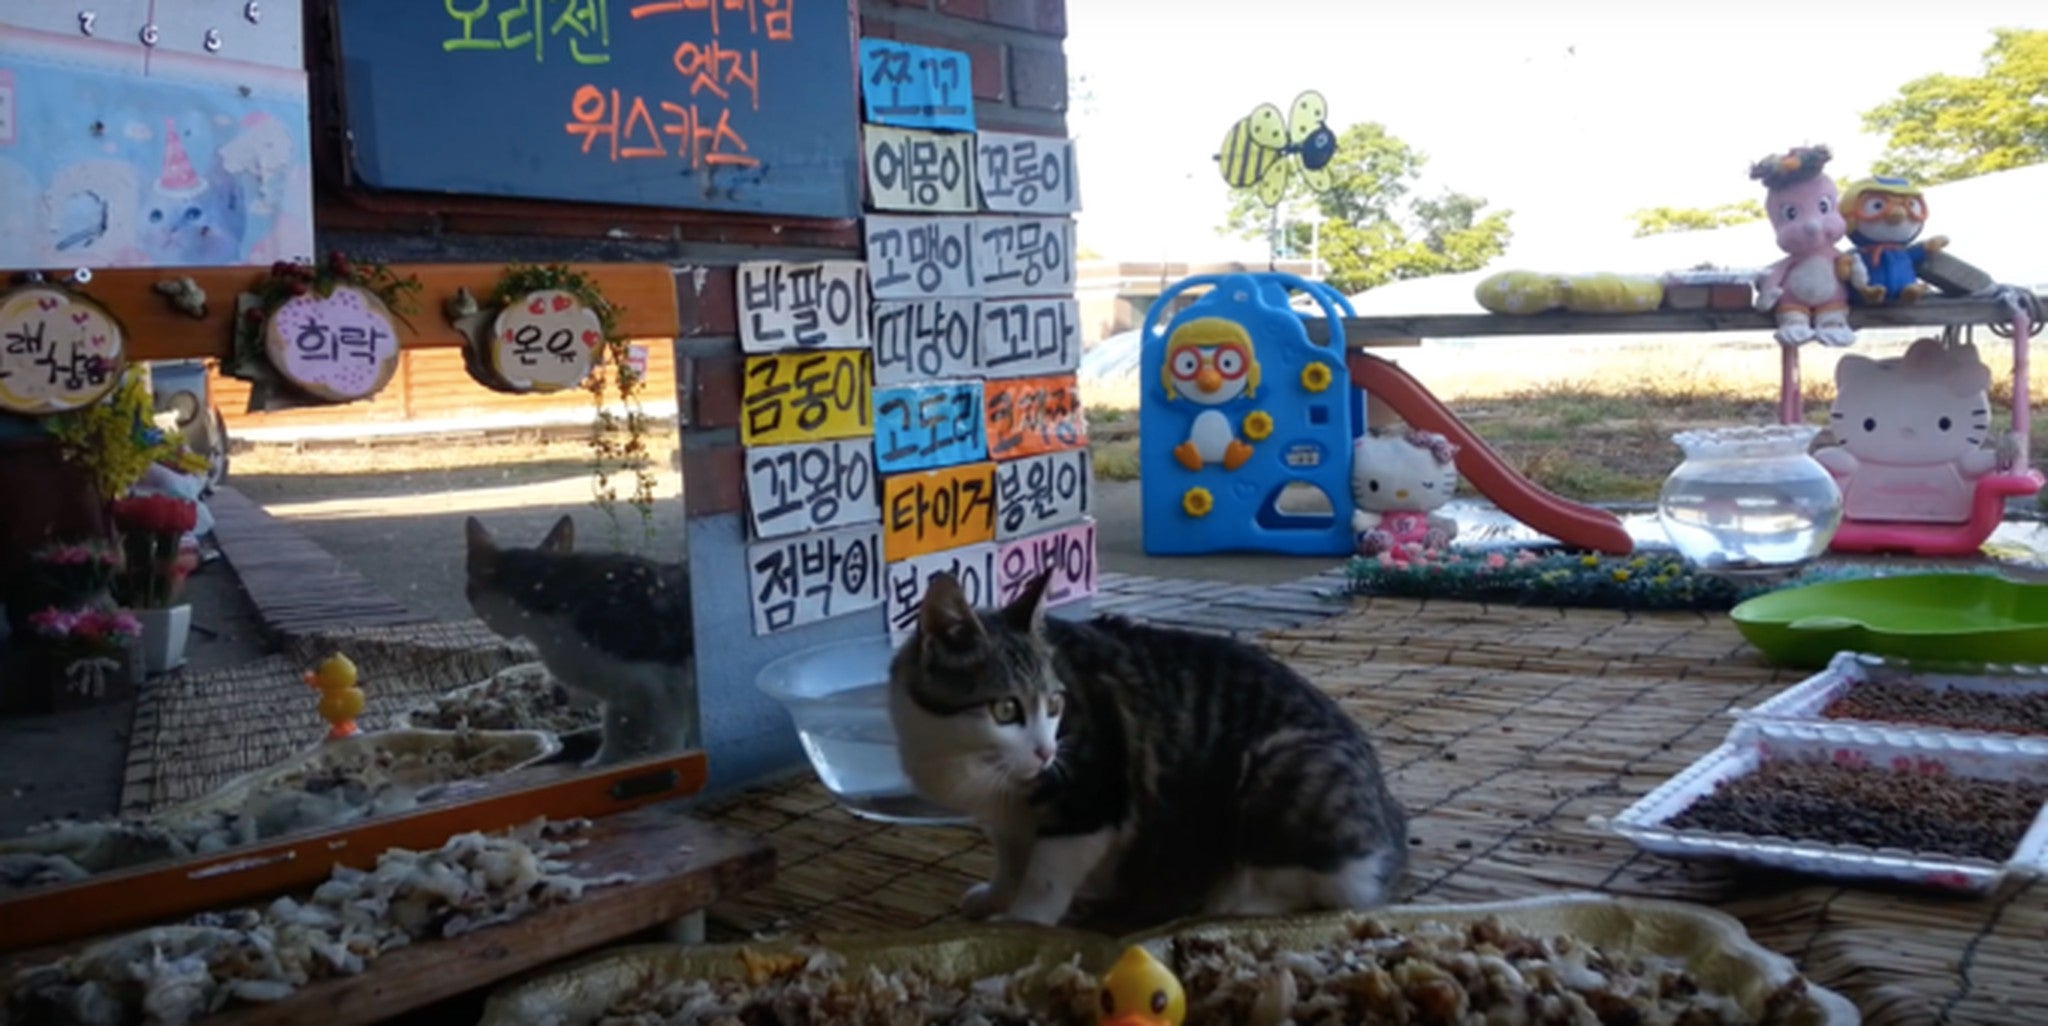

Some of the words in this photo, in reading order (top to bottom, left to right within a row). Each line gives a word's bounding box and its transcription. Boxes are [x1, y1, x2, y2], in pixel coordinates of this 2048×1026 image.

[868, 47, 967, 116] 쪼꼬
[566, 84, 761, 168] 위스카스
[873, 136, 972, 208] 에몽이
[980, 140, 1072, 207] 꼬롱이
[869, 223, 975, 292] 꼬맹이
[982, 221, 1070, 287] 꼬뭉이
[296, 315, 388, 365] 희락
[744, 265, 863, 345] 반팔이
[876, 301, 981, 375] 띠냥이
[986, 302, 1074, 368] 꼬마
[513, 325, 577, 365] 온유
[745, 352, 867, 436] 금동이
[879, 390, 981, 461] 고도리
[752, 441, 880, 525] 꼬왕이
[892, 470, 996, 541] 타이거
[755, 534, 879, 631] 점박이
